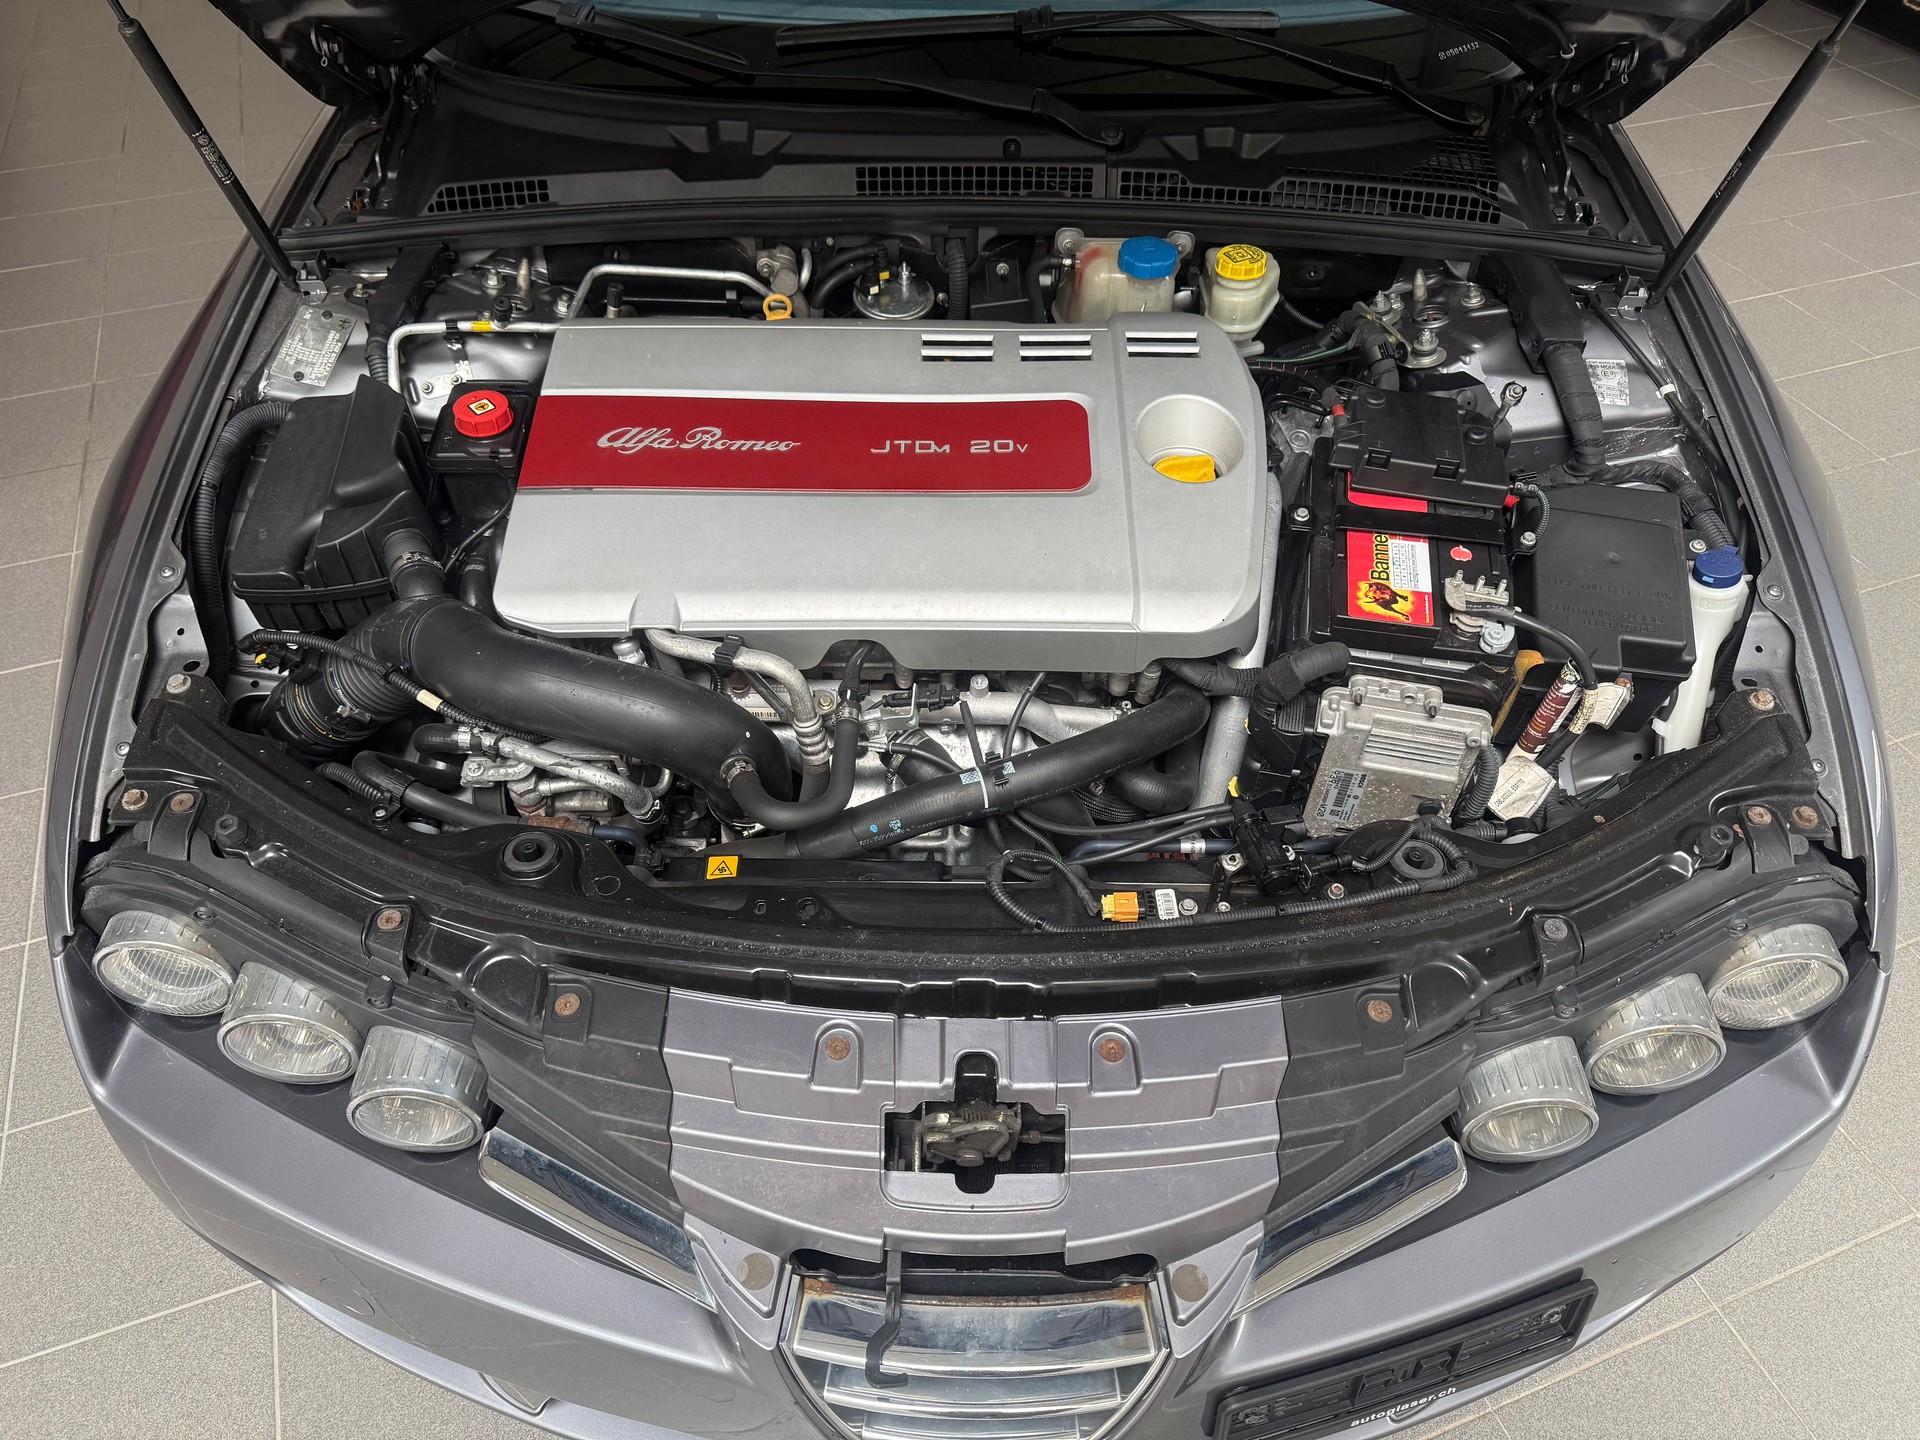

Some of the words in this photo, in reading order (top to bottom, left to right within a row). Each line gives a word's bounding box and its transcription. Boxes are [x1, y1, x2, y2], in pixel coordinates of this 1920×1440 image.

[597, 427, 680, 454] Alfa
[679, 426, 801, 451] Romeo
[1350, 1387, 1457, 1427] autoglaser.ch
